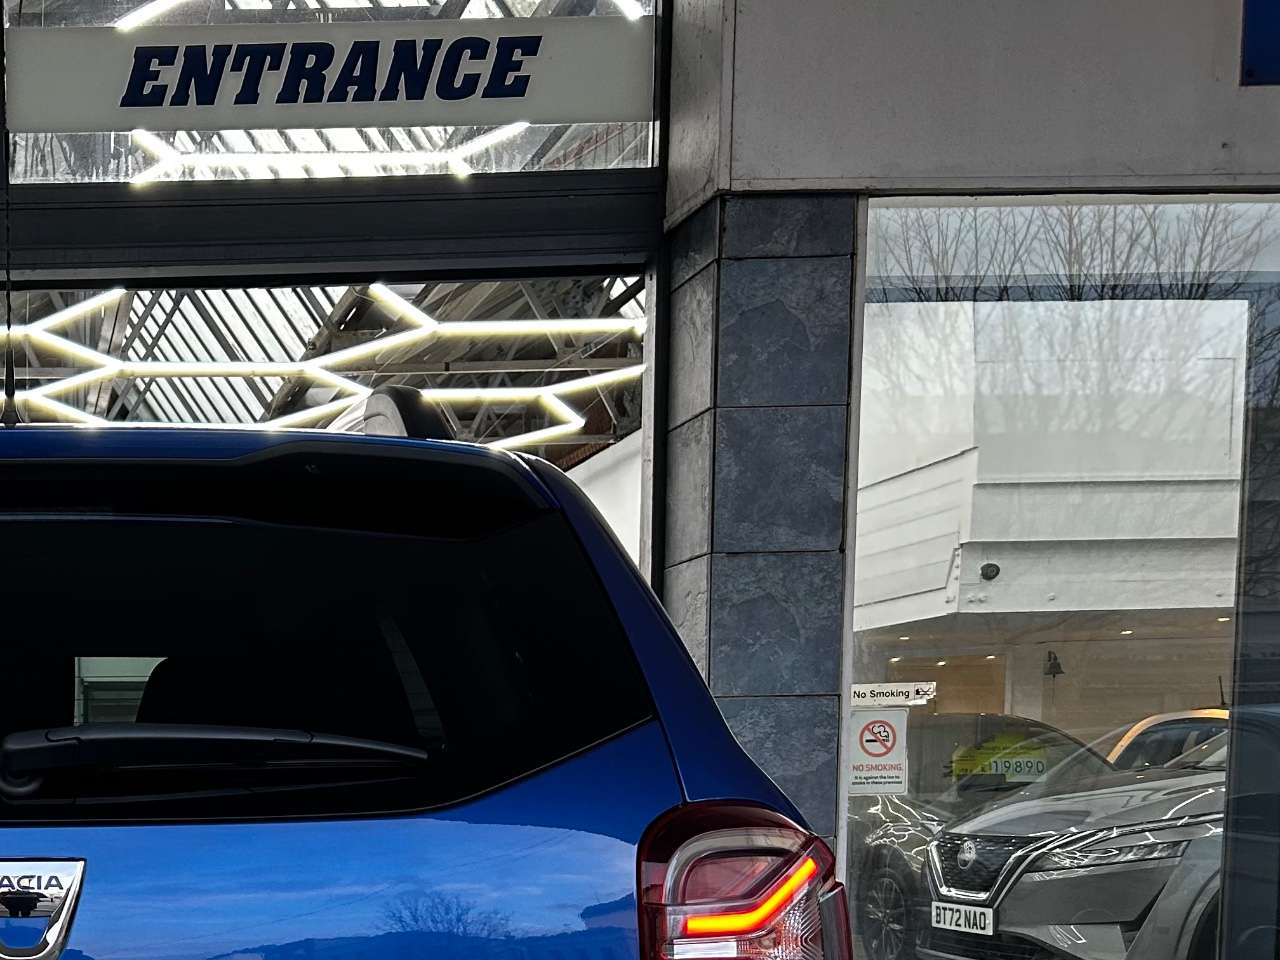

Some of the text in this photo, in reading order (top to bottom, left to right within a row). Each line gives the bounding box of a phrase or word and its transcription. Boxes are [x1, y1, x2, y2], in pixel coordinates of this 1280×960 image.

[119, 36, 543, 107] ENTRANCE
[853, 688, 910, 699] No Smoking
[935, 905, 987, 931] BT72 NAO
